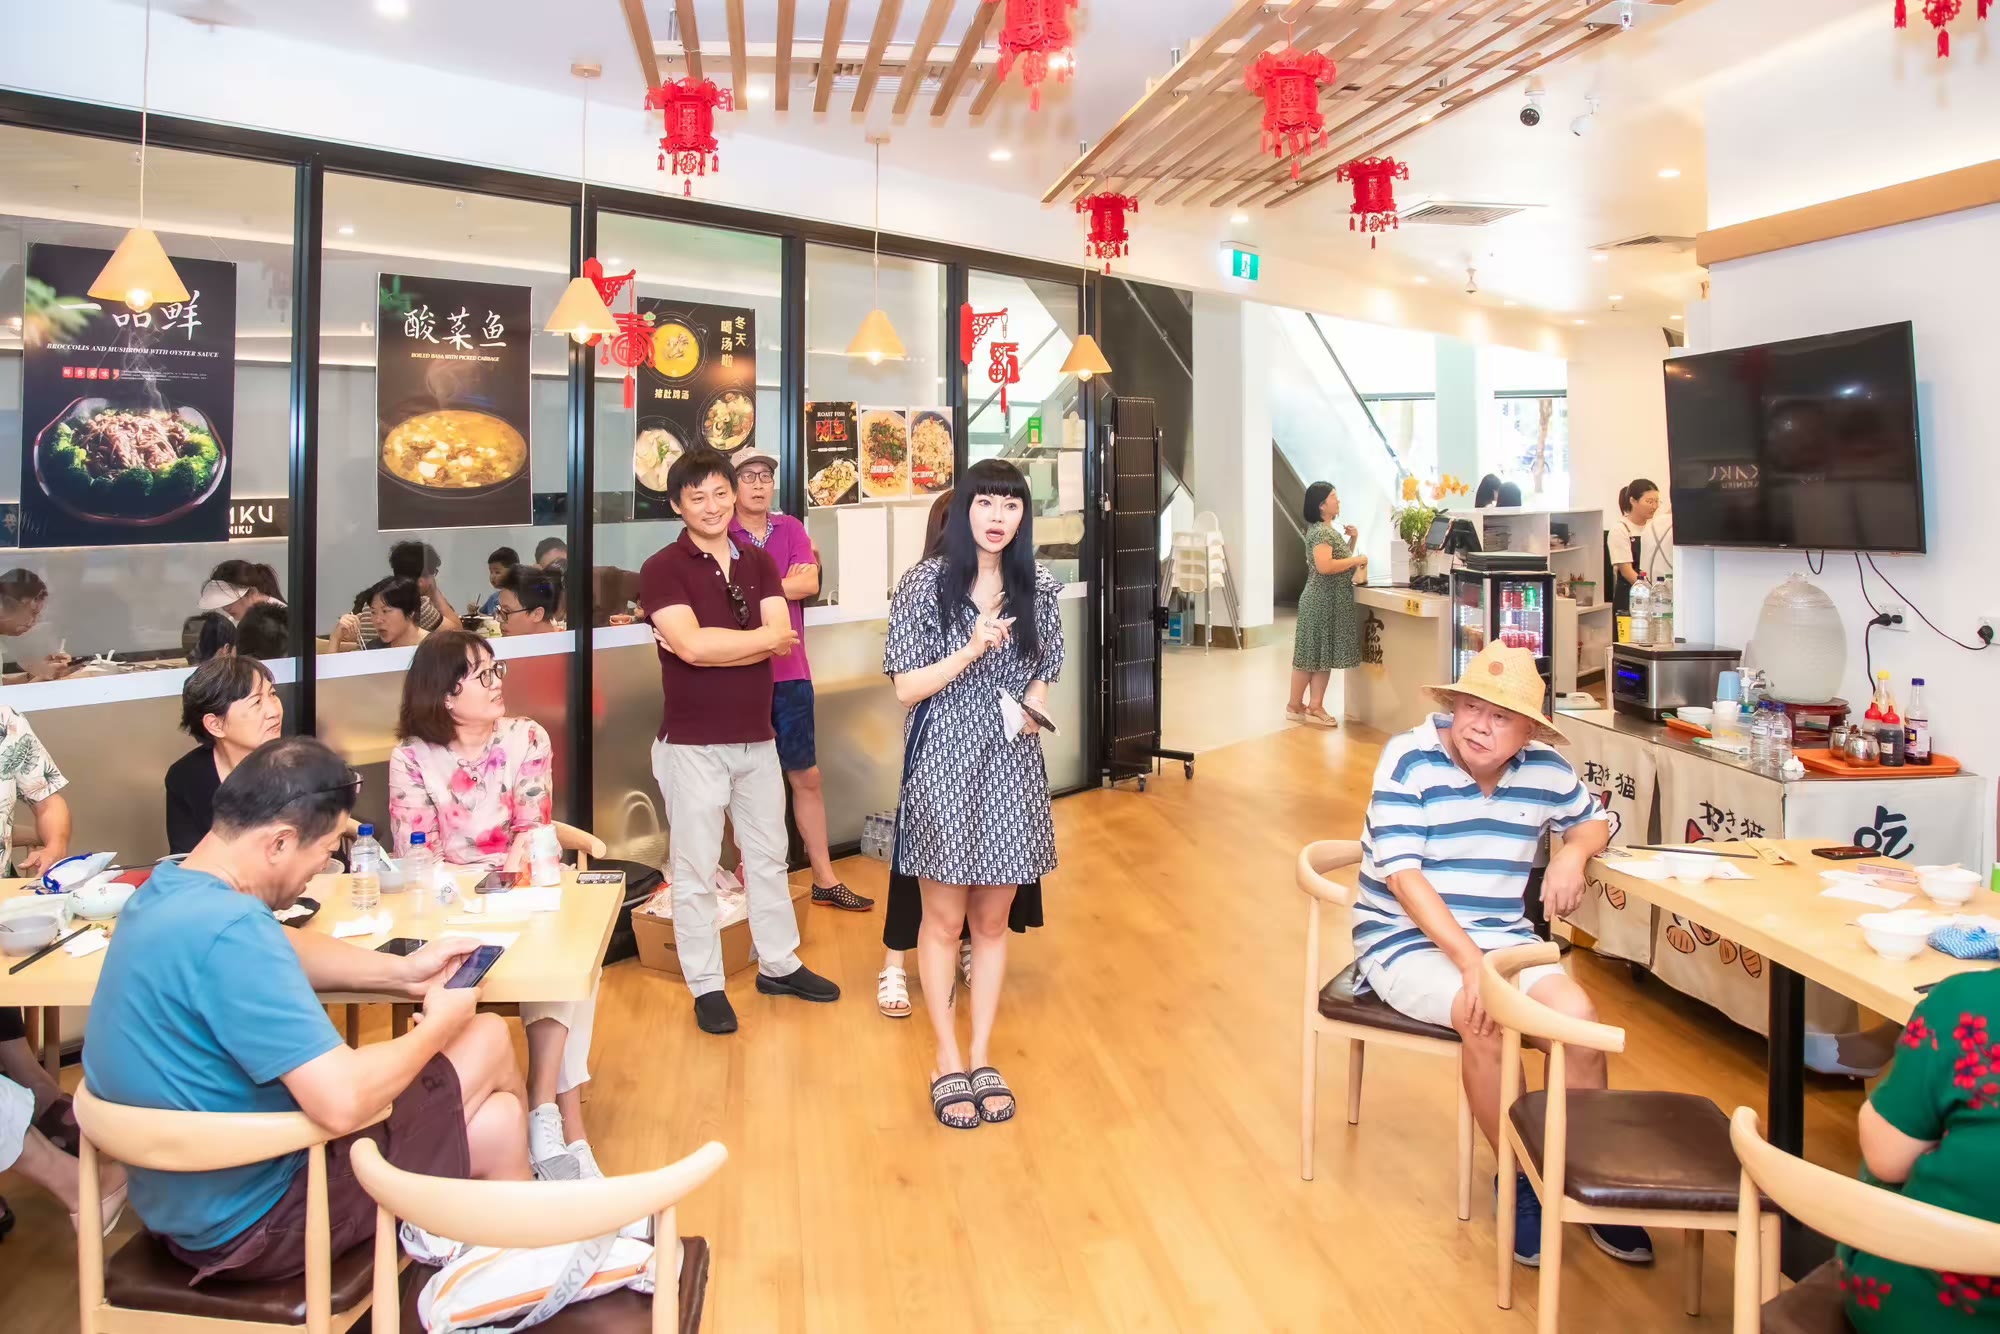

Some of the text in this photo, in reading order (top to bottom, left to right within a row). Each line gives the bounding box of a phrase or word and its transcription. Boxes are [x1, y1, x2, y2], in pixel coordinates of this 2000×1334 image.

[61, 289, 203, 341] 一品鲜
[403, 304, 507, 351] 酸菜鱼
[734, 315, 747, 347] 冬天
[46, 343, 220, 359] BROCCOLIS AND MUSHROOM WITH OYSTER SAUCE
[411, 352, 431, 360] BOILED
[720, 320, 734, 369] 喝汤啦
[1853, 805, 1915, 860] 吃
[554, 1258, 586, 1305] SKY
